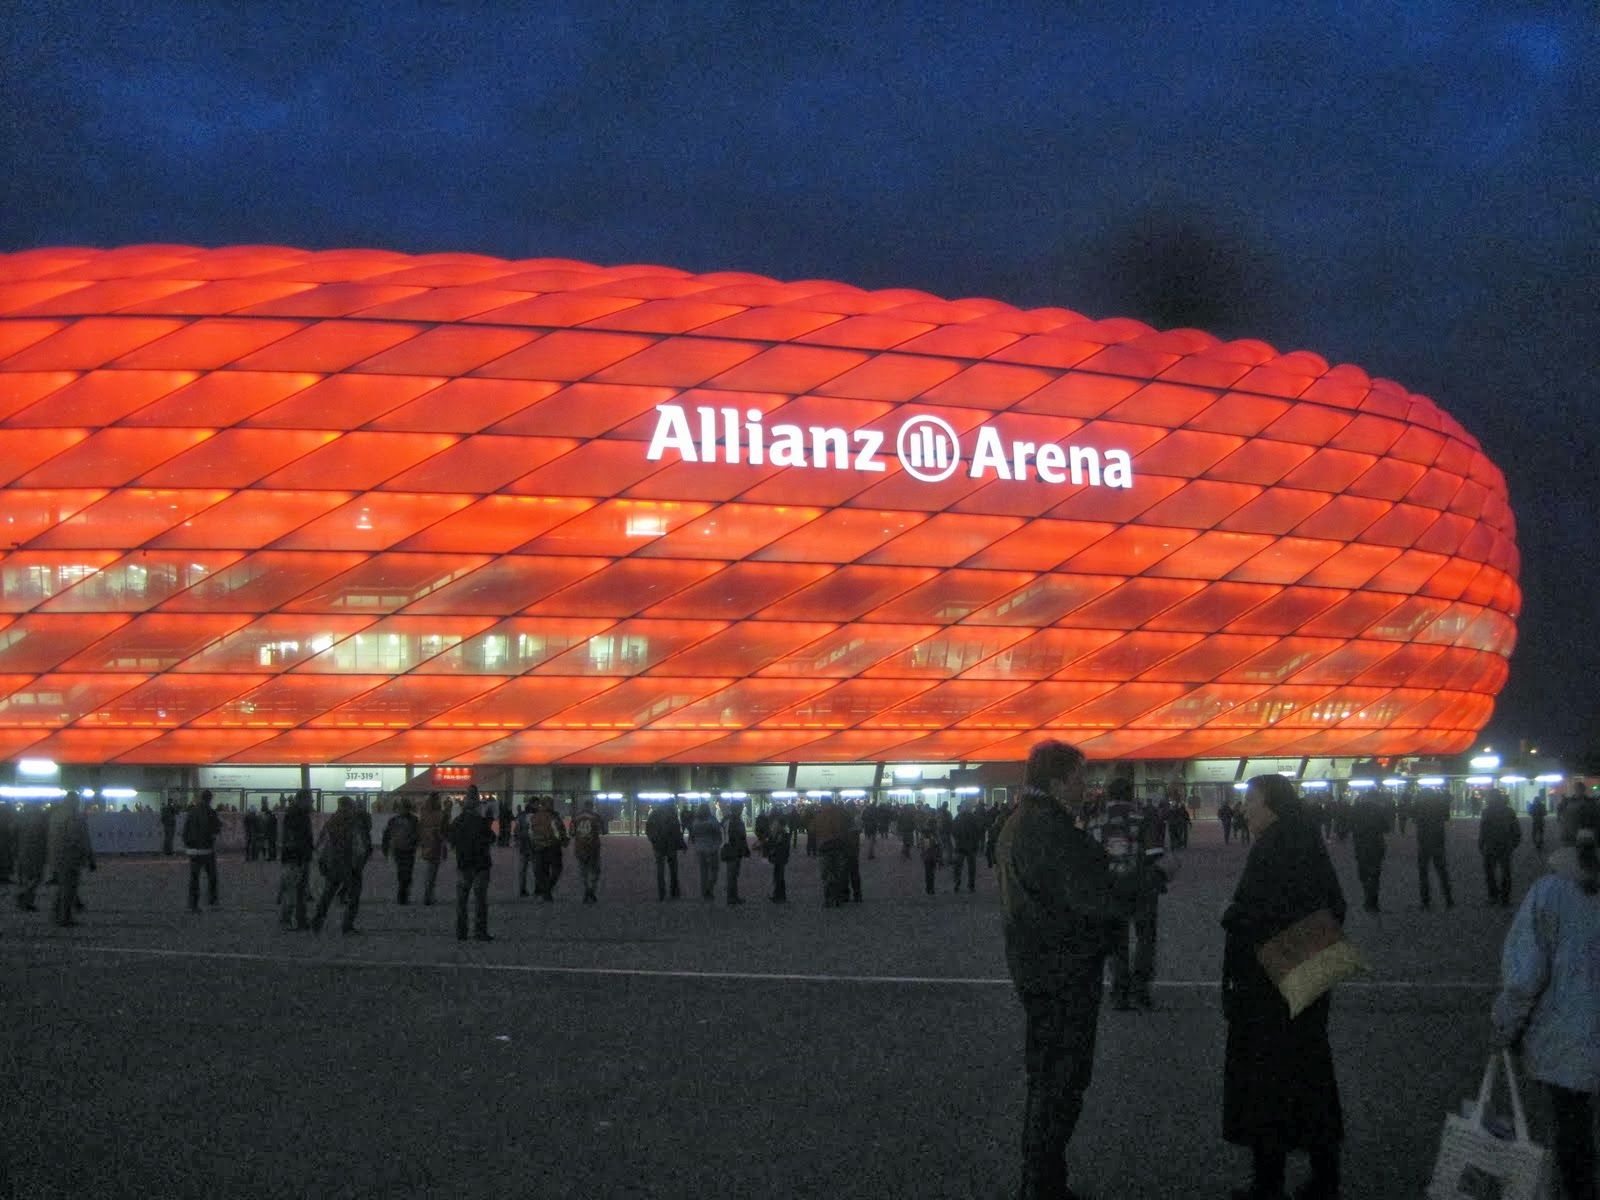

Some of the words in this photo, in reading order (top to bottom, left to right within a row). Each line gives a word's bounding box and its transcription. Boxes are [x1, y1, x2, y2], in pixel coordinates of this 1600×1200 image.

[646, 404, 886, 472] Allianz
[970, 426, 1133, 489] Arena
[345, 772, 374, 780] 317-319
